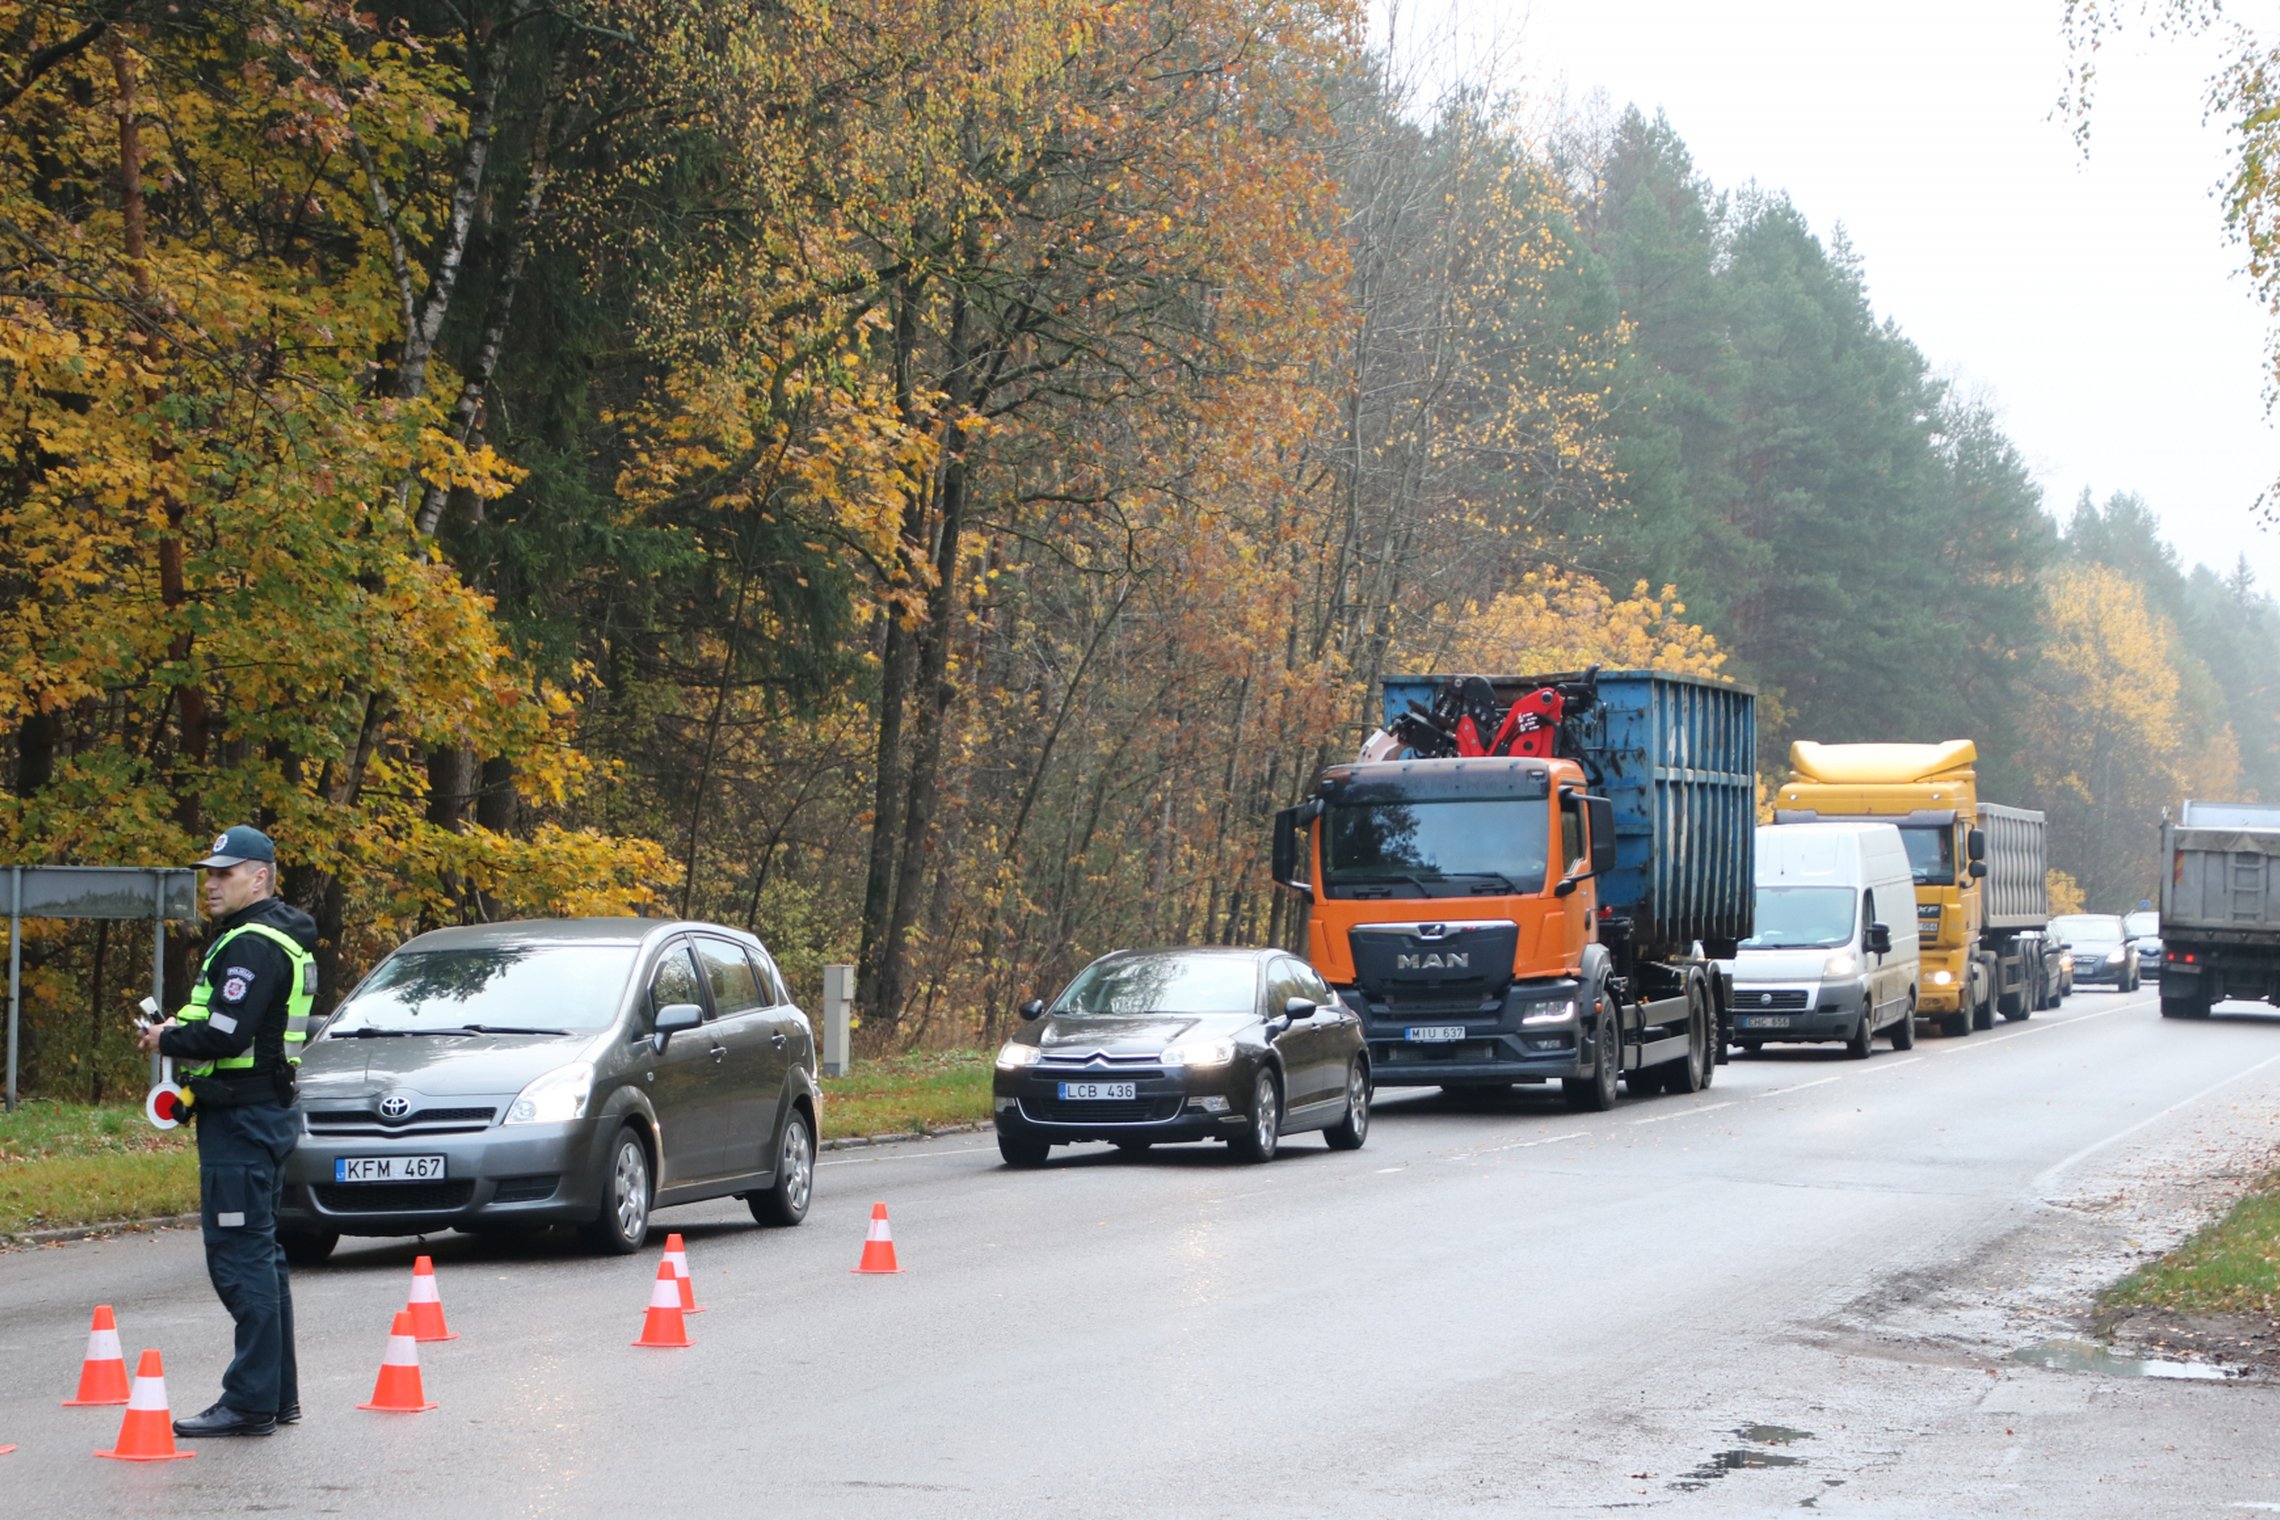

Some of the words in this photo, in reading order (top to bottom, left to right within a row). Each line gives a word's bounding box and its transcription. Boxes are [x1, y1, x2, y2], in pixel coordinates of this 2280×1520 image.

[1397, 953, 1468, 969] MAN
[1412, 1028, 1436, 1039] MIU
[1443, 1027, 1464, 1038] 637
[1067, 1085, 1097, 1098] LCB
[1107, 1085, 1133, 1098] 436
[348, 1160, 390, 1179] KFM
[405, 1158, 440, 1177] 467
